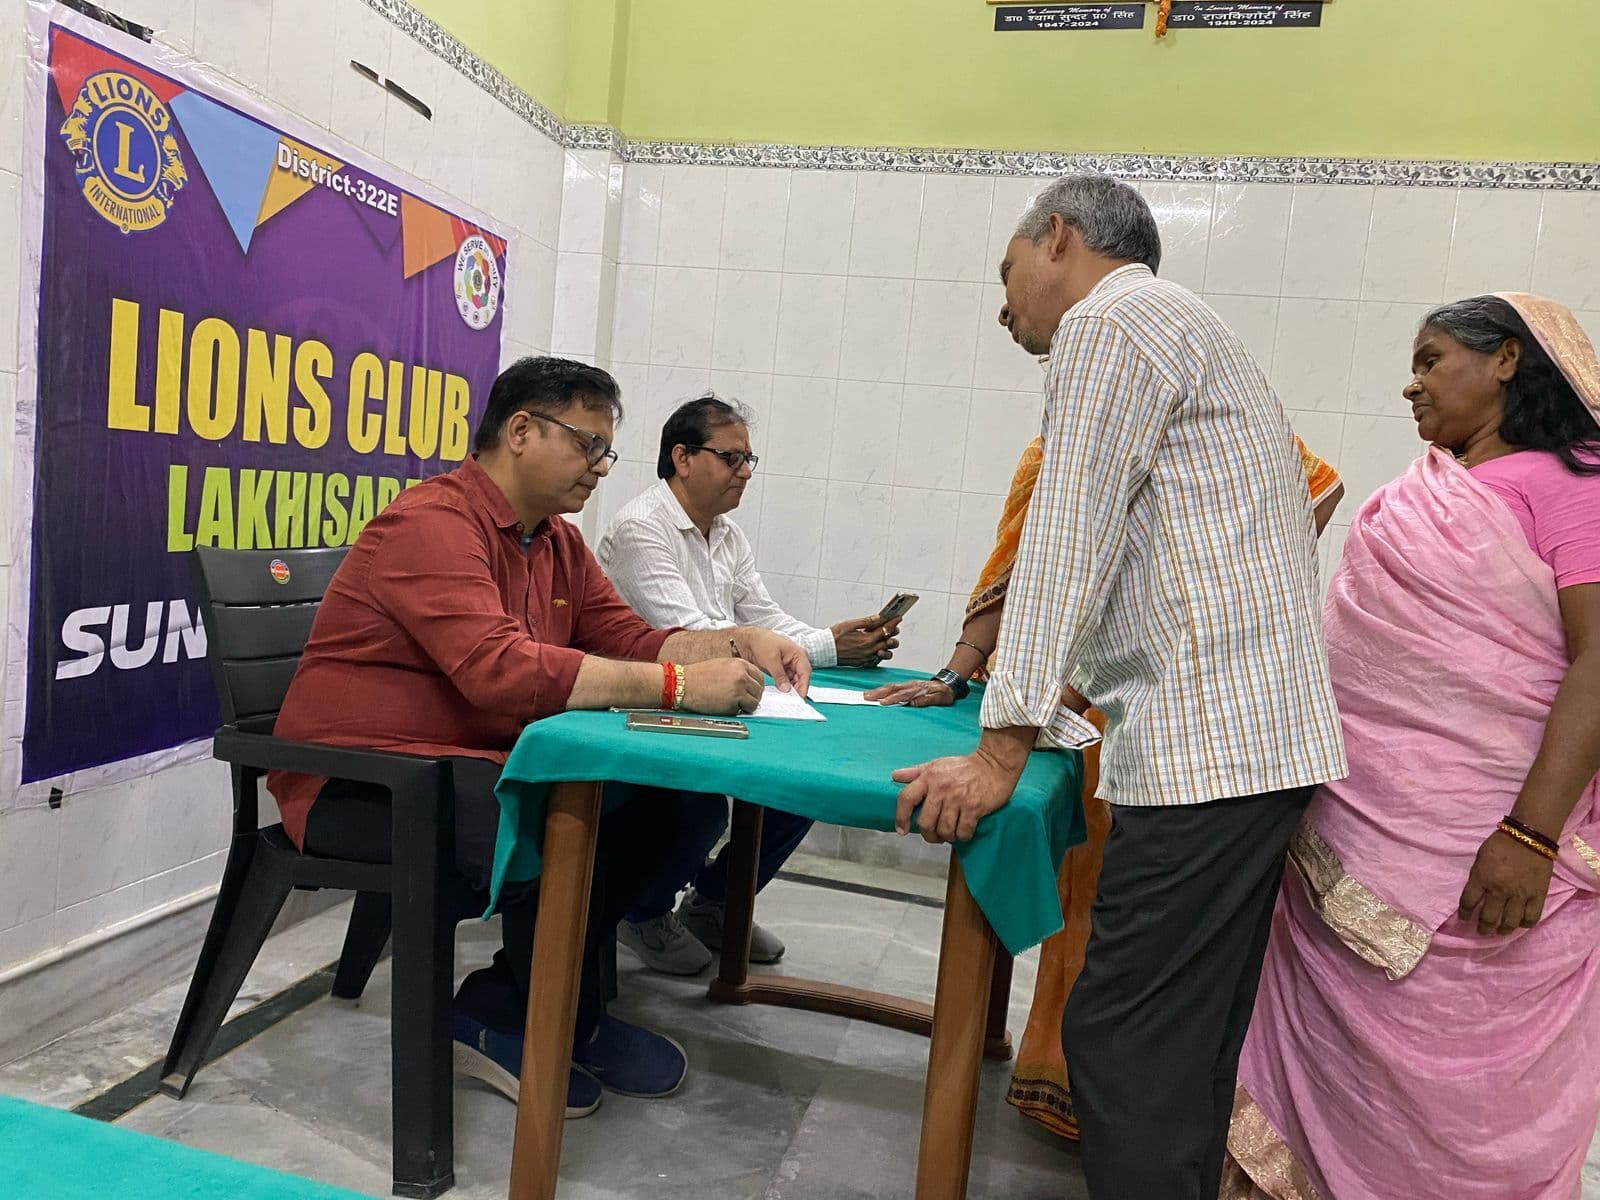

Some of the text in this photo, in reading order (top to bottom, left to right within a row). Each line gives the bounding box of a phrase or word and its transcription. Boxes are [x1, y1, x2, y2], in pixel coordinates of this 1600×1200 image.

[1028, 14, 1056, 22] श्याम
[1113, 10, 1135, 19] सिंह
[1068, 7, 1101, 15] Memory
[1101, 6, 1112, 14] of
[1275, 3, 1285, 11] of
[1283, 9, 1312, 19] सिंह
[92, 77, 165, 127] LIONS
[113, 121, 145, 184] L
[278, 142, 398, 217] District-322E
[89, 184, 161, 224] INTERNATIONAL
[463, 239, 484, 255] SERVE
[107, 297, 471, 462] LIONS CLUB
[167, 464, 422, 553] LAKHISA
